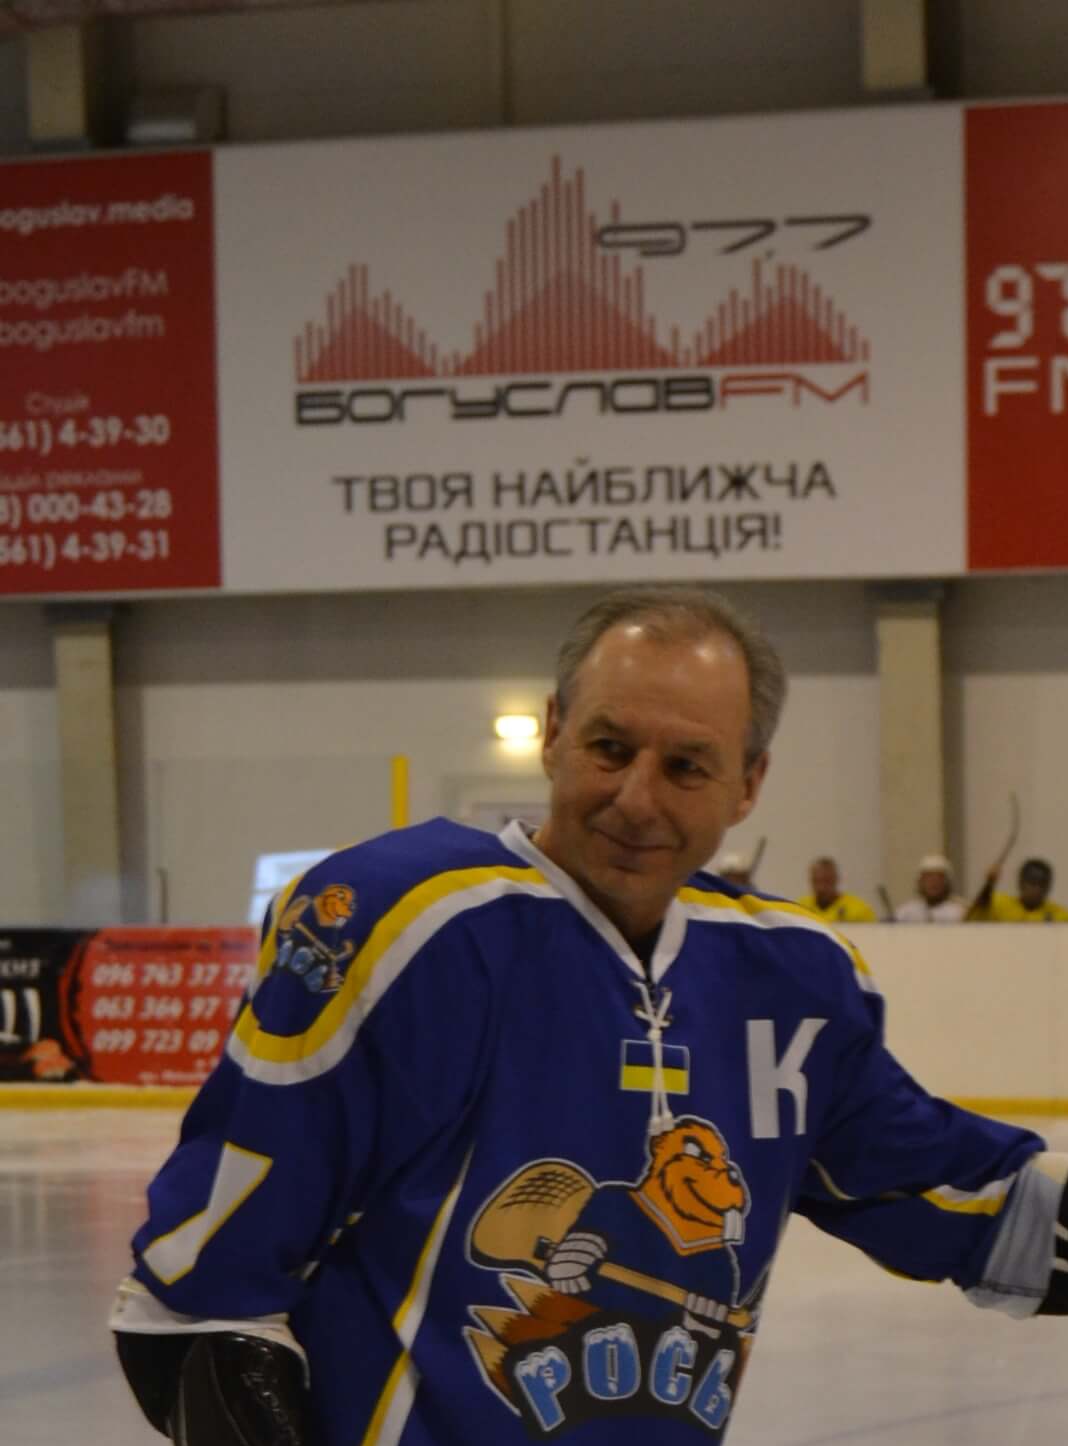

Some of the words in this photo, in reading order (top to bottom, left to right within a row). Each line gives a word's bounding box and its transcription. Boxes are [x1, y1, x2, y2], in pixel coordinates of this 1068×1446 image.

[58, 414, 171, 448] 4-39-30
[334, 474, 474, 512] ТВОЯ
[492, 457, 838, 508] НАЙБЛИЖЧА
[27, 487, 173, 525] 000-43-28
[61, 527, 171, 562] 4-39-31
[385, 512, 783, 564] РАДІОСТАНЦІЯ!
